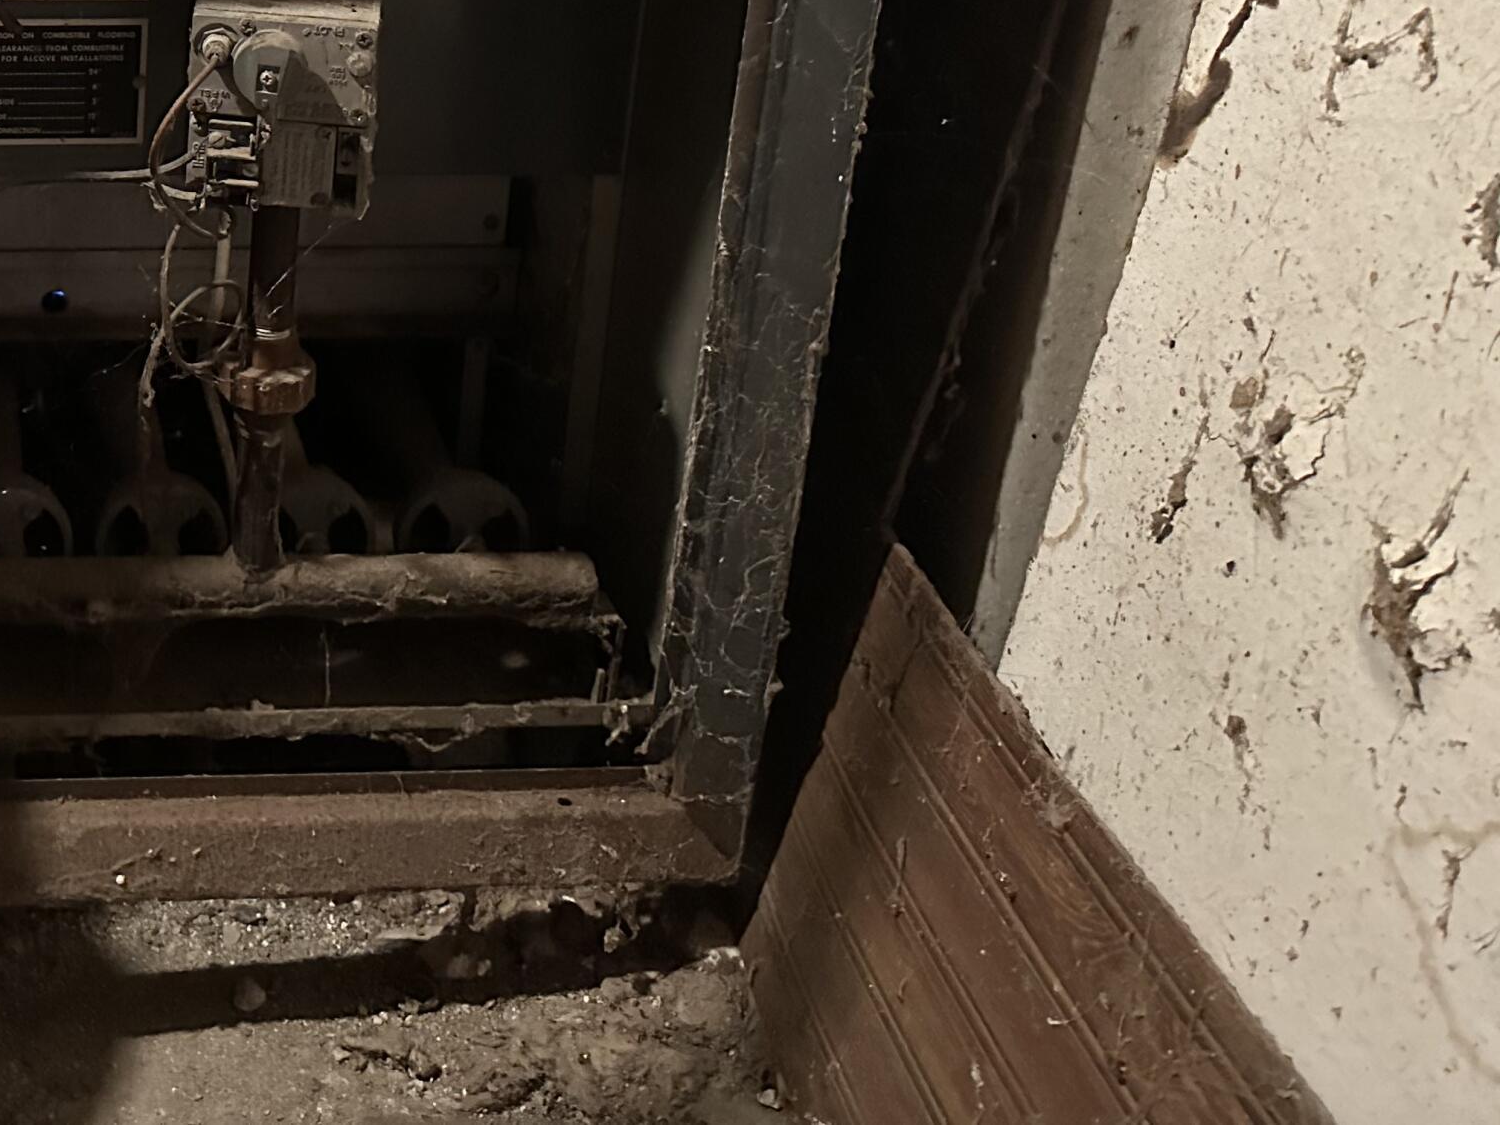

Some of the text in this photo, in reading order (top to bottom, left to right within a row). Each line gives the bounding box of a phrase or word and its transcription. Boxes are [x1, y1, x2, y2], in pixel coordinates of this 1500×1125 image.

[21, 32, 34, 40] ON
[42, 31, 91, 39] COMBUSTIBLE
[45, 44, 69, 52] FROM
[72, 44, 125, 52] COMBUSTIBLE
[60, 54, 125, 62] INSTALLATIONS
